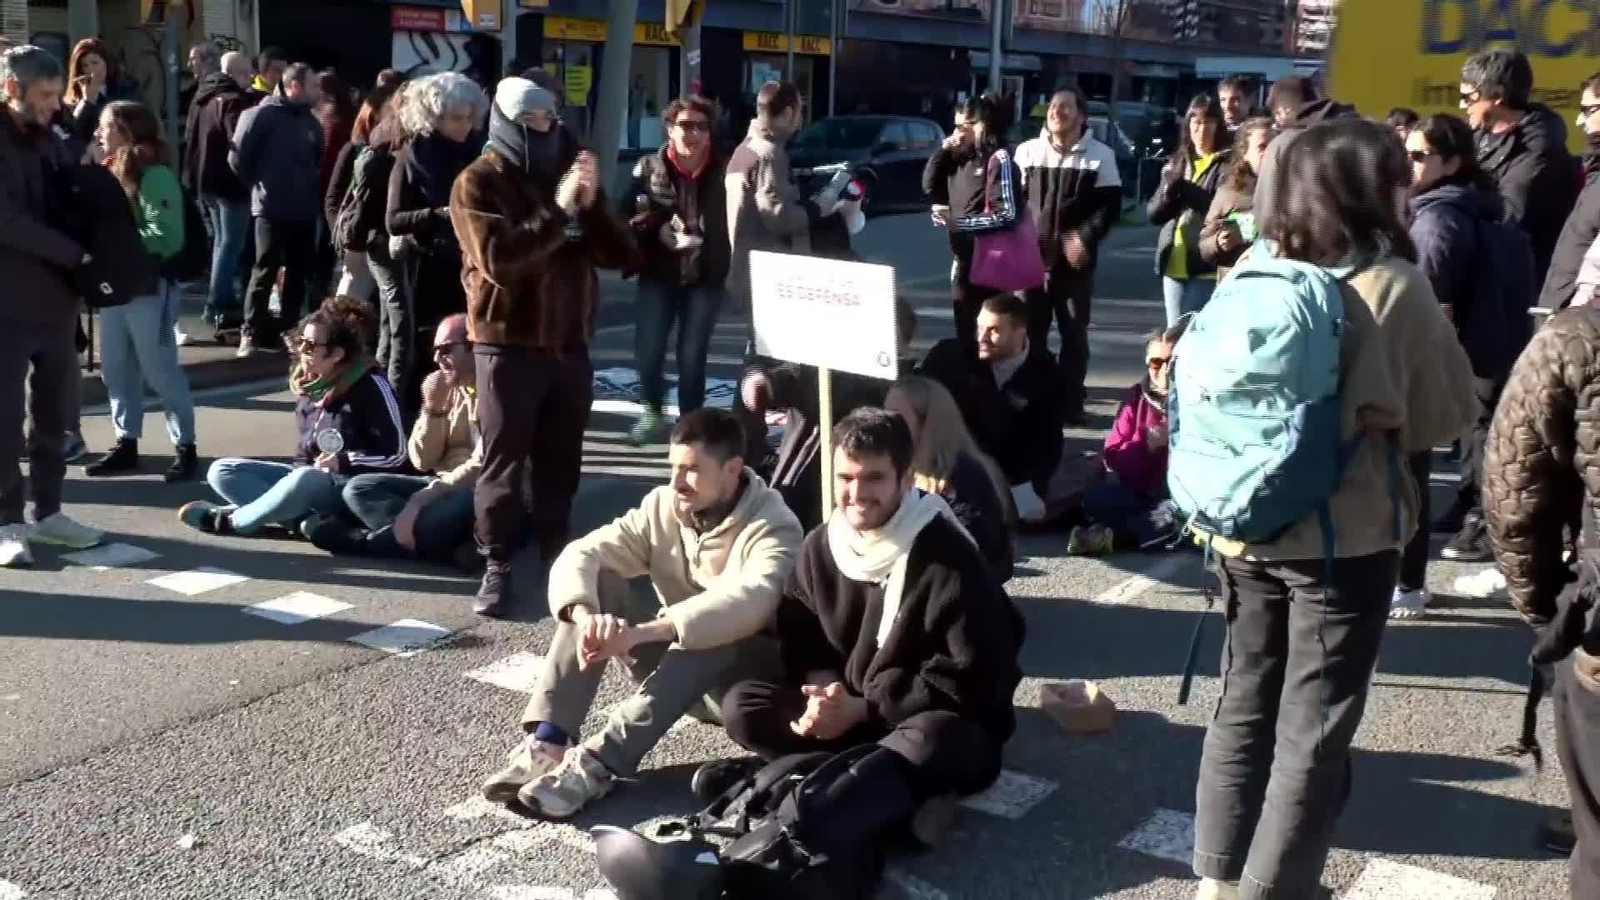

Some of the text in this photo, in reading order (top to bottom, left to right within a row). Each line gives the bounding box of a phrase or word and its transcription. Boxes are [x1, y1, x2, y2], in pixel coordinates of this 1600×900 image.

[757, 33, 779, 48] RACC
[801, 36, 821, 51] RACC
[797, 285, 862, 307] DEFENSA
